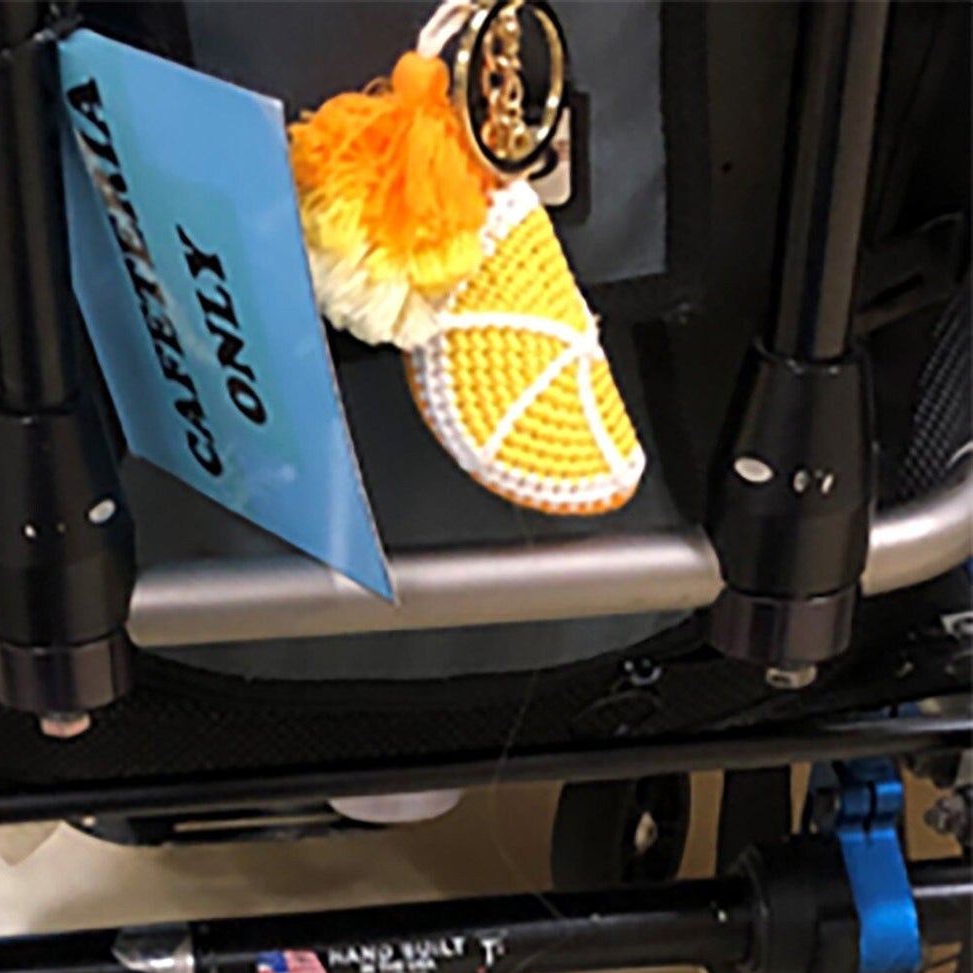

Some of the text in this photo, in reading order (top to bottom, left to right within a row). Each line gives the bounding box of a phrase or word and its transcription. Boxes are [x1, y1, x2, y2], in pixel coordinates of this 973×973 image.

[67, 77, 223, 476] CAFETERIA
[175, 223, 267, 425] ONLY
[328, 936, 466, 967] HAND BUILT
